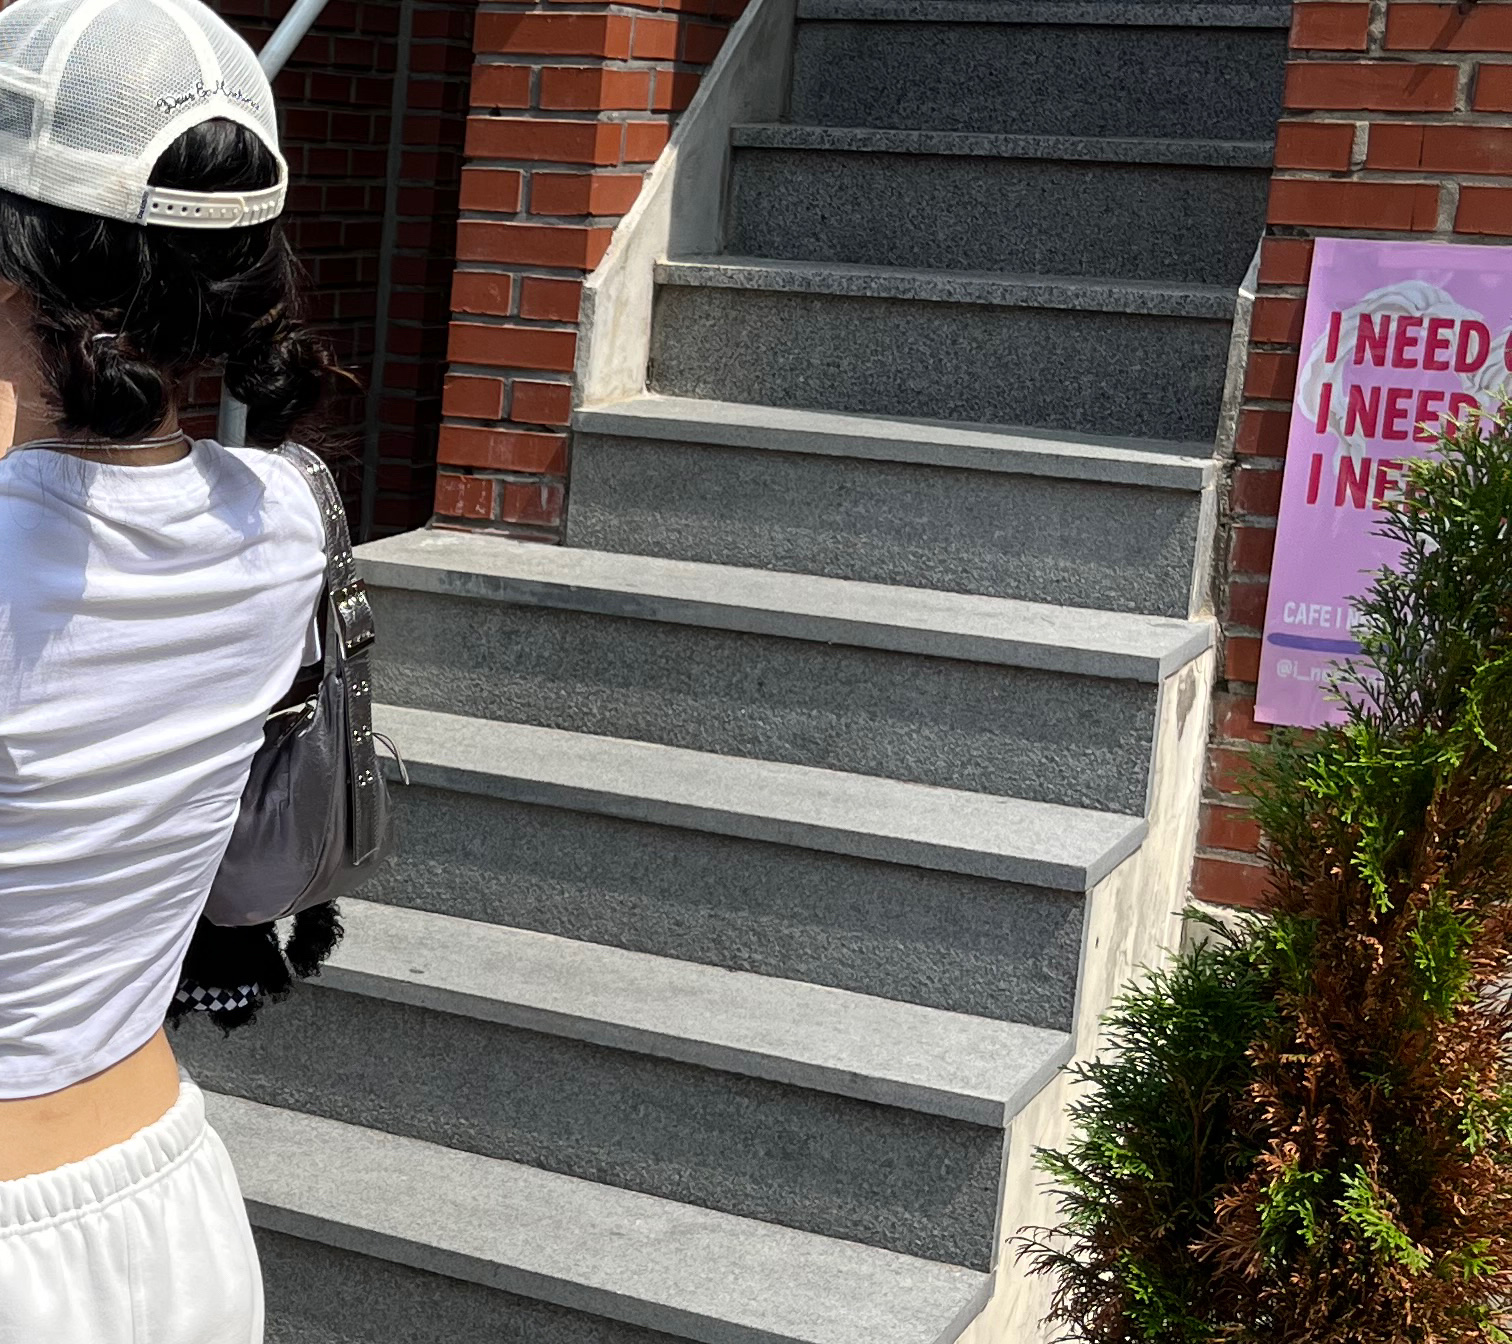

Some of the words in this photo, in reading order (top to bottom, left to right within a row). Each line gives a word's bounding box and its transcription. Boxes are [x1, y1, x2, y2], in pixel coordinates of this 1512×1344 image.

[1324, 311, 1342, 363] I
[1353, 313, 1491, 373] NEED
[1315, 382, 1333, 434] I
[1306, 453, 1323, 504] I
[1283, 601, 1332, 628] CAFE
